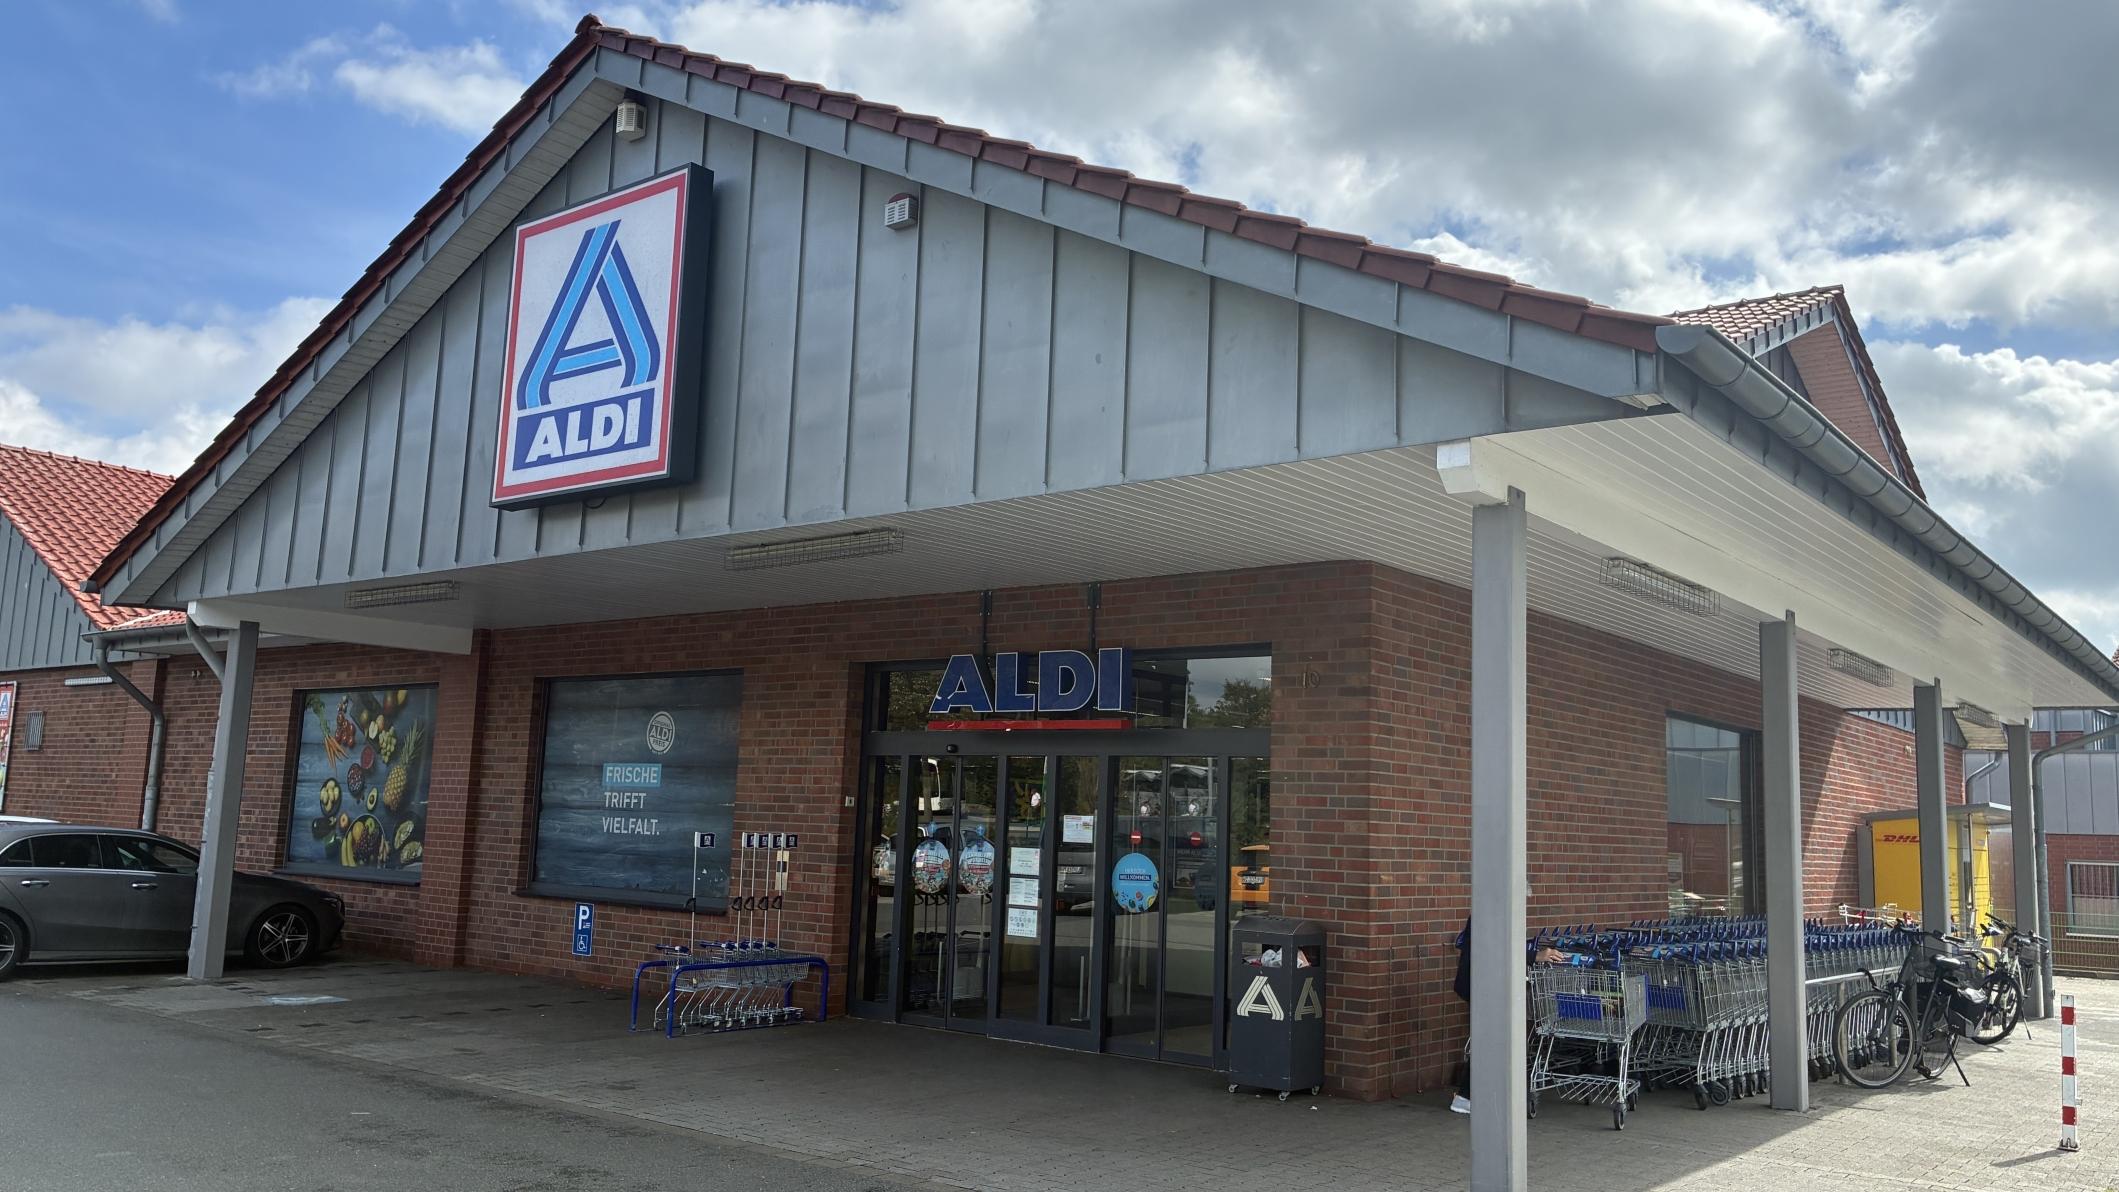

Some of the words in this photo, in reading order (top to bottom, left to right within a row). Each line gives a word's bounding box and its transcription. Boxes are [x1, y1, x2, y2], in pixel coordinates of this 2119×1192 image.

[525, 398, 642, 464] ALDI
[929, 648, 1122, 713] ALDI
[650, 726, 672, 741] ALDI
[606, 767, 658, 783] FRISCHE
[604, 792, 646, 808] TRIFFT
[602, 816, 660, 835] VIELFALT.
[1883, 834, 1920, 843] DHL
[578, 905, 590, 930] P
